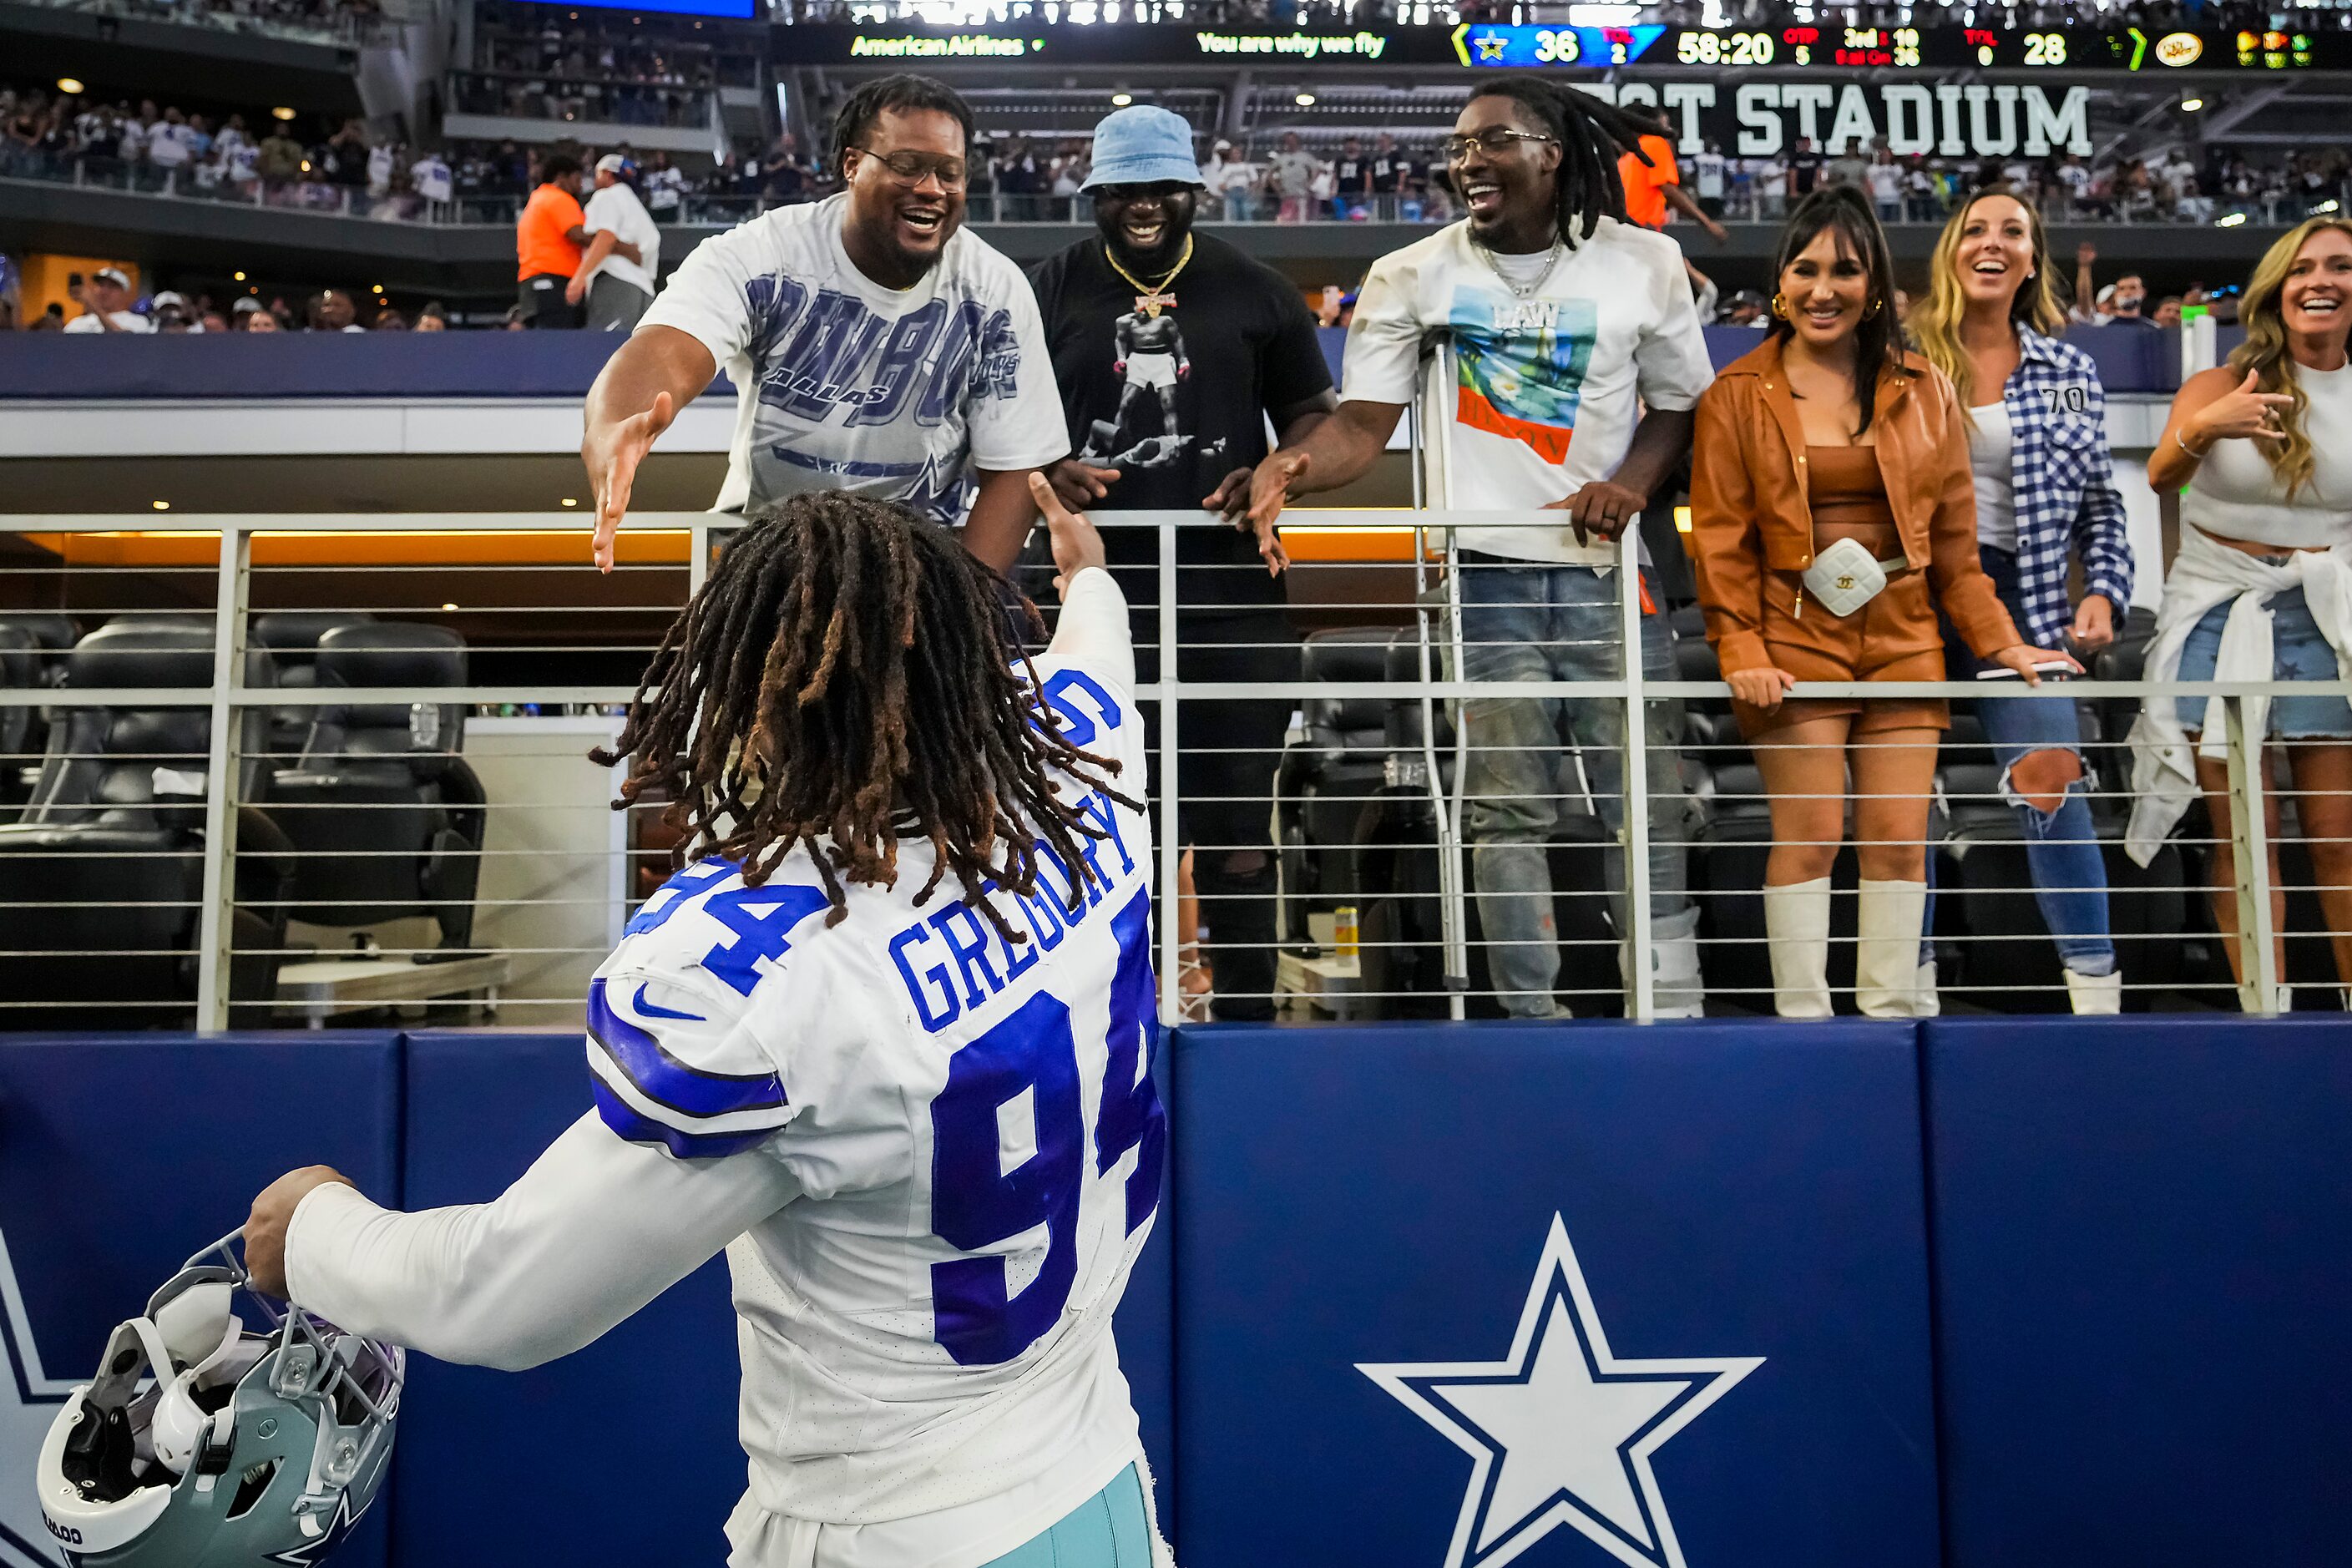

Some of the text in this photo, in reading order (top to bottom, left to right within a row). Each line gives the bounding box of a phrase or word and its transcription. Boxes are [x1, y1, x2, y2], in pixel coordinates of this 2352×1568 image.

[850, 35, 1025, 56] American Airlines
[1196, 31, 1386, 58] You are why we fly
[1534, 30, 1579, 63] 36
[1611, 43, 1626, 64] 2
[1677, 32, 1775, 65] 58:20
[1844, 28, 1878, 48] 3rd
[1893, 28, 1920, 48] 10
[2024, 33, 2067, 66] 28
[1795, 45, 1810, 66] 5
[1977, 45, 1994, 66] 0
[1736, 83, 2094, 157] STADIUM
[763, 367, 891, 407] ALLAS
[2041, 387, 2085, 414] 70
[622, 853, 832, 998] 94
[888, 789, 1136, 1034] GREGORY
[929, 883, 1167, 1366] 94
[41, 1509, 83, 1545] COW
